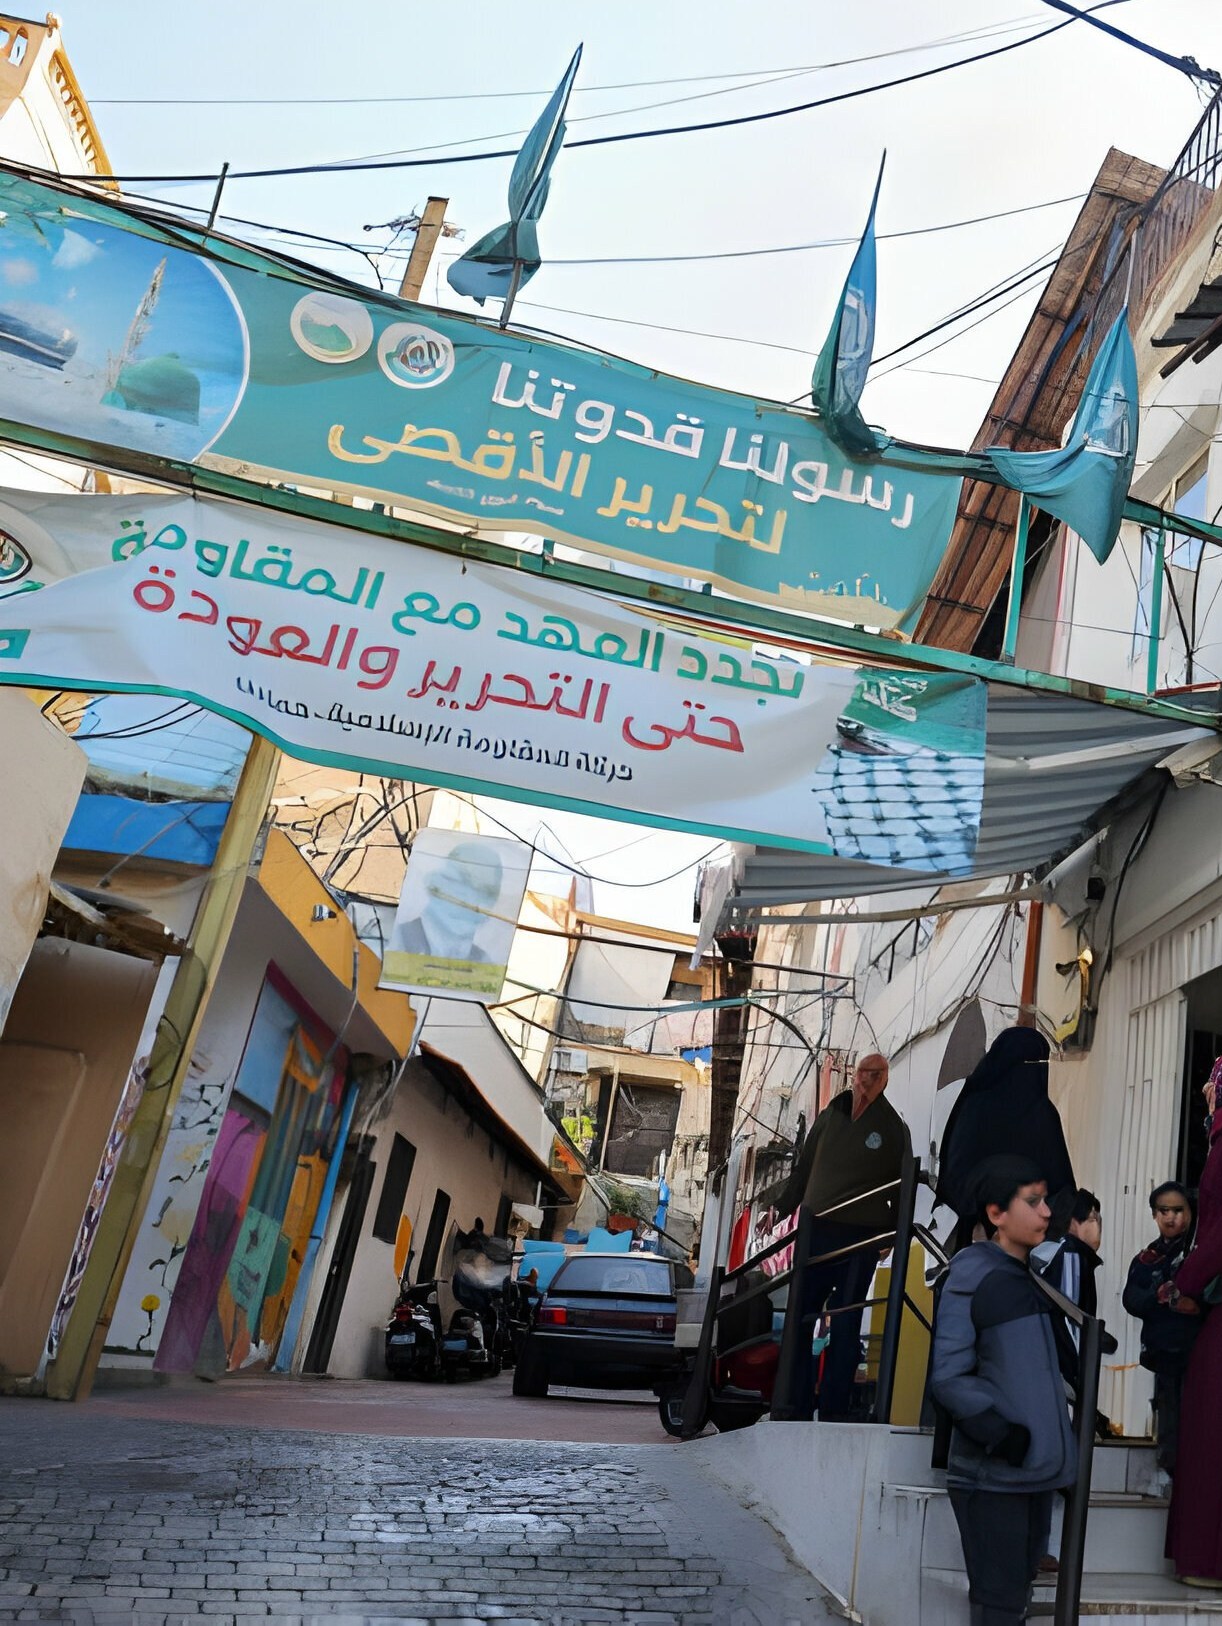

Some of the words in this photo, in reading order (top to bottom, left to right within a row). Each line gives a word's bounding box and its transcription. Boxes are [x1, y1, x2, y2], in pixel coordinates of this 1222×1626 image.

[491, 361, 704, 459] قدوتنا
[327, 423, 591, 497] الأقصى
[718, 427, 914, 529] رسولنا
[596, 477, 787, 554] لتحرير
[111, 520, 384, 610] المقاومة
[133, 565, 399, 691] والعودة
[392, 591, 481, 636] مع
[497, 611, 665, 673] العهد
[407, 661, 610, 724] التحرير
[622, 700, 744, 753] حتى
